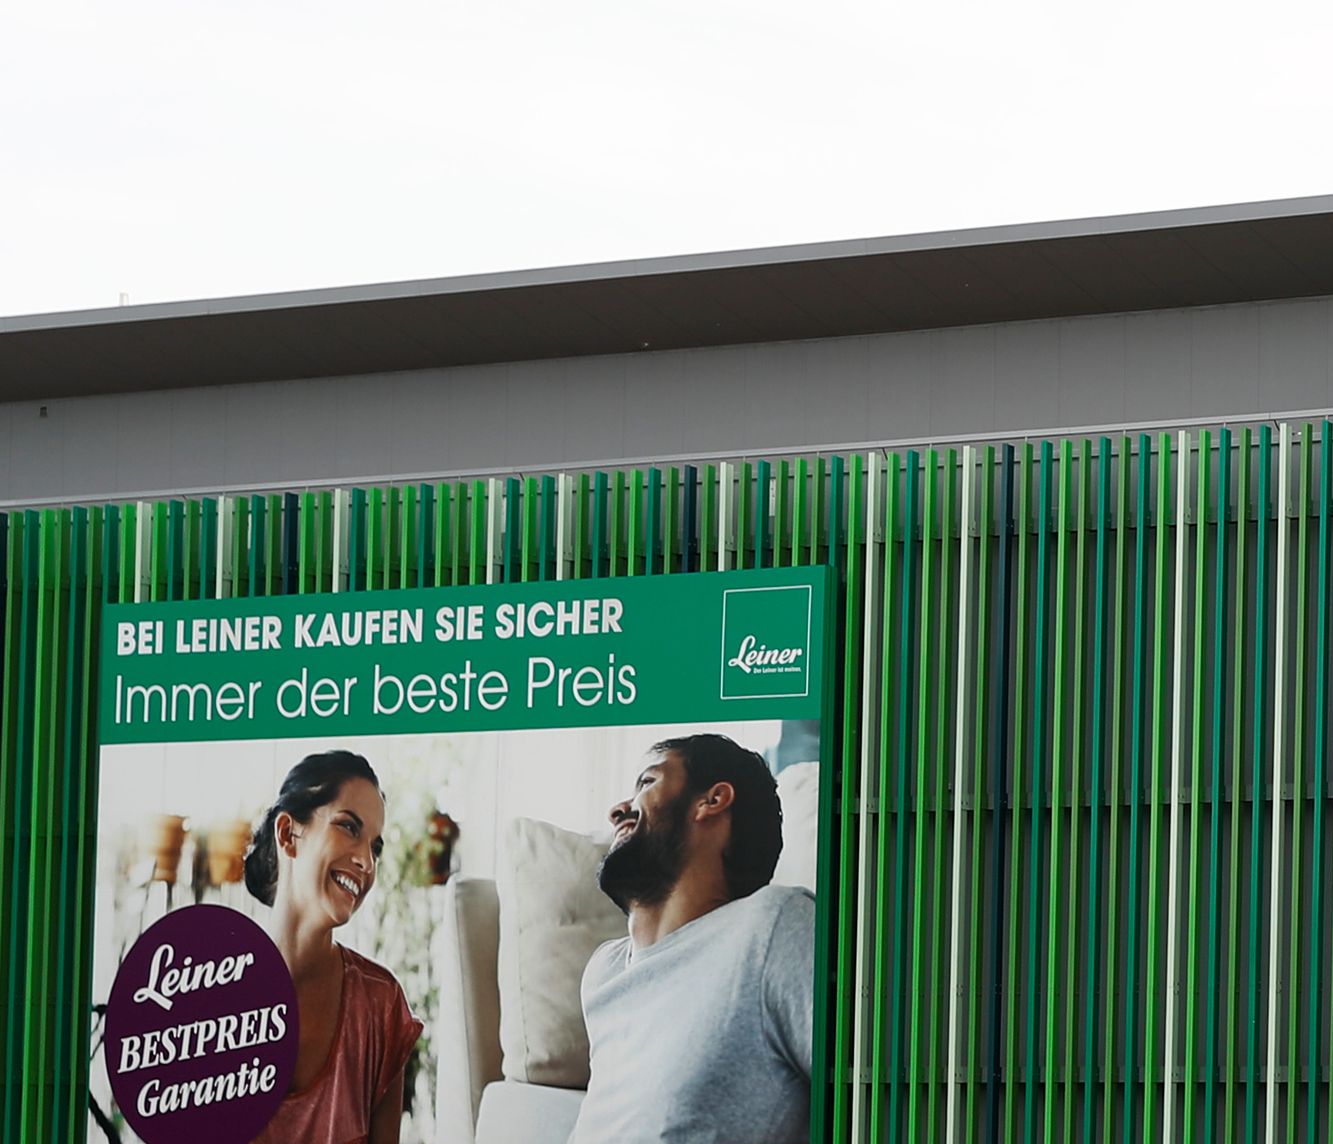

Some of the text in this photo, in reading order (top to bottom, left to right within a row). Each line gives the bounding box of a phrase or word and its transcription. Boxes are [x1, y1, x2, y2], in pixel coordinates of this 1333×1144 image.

[117, 598, 624, 656] BEI LEINER KAUFEN SIE SICHER
[728, 635, 803, 674] Leiner
[115, 653, 637, 724] Immer der beste Preis
[132, 943, 254, 1011] Leiner
[117, 1003, 288, 1074] BESTPREIS
[136, 1057, 277, 1118] Garantie
